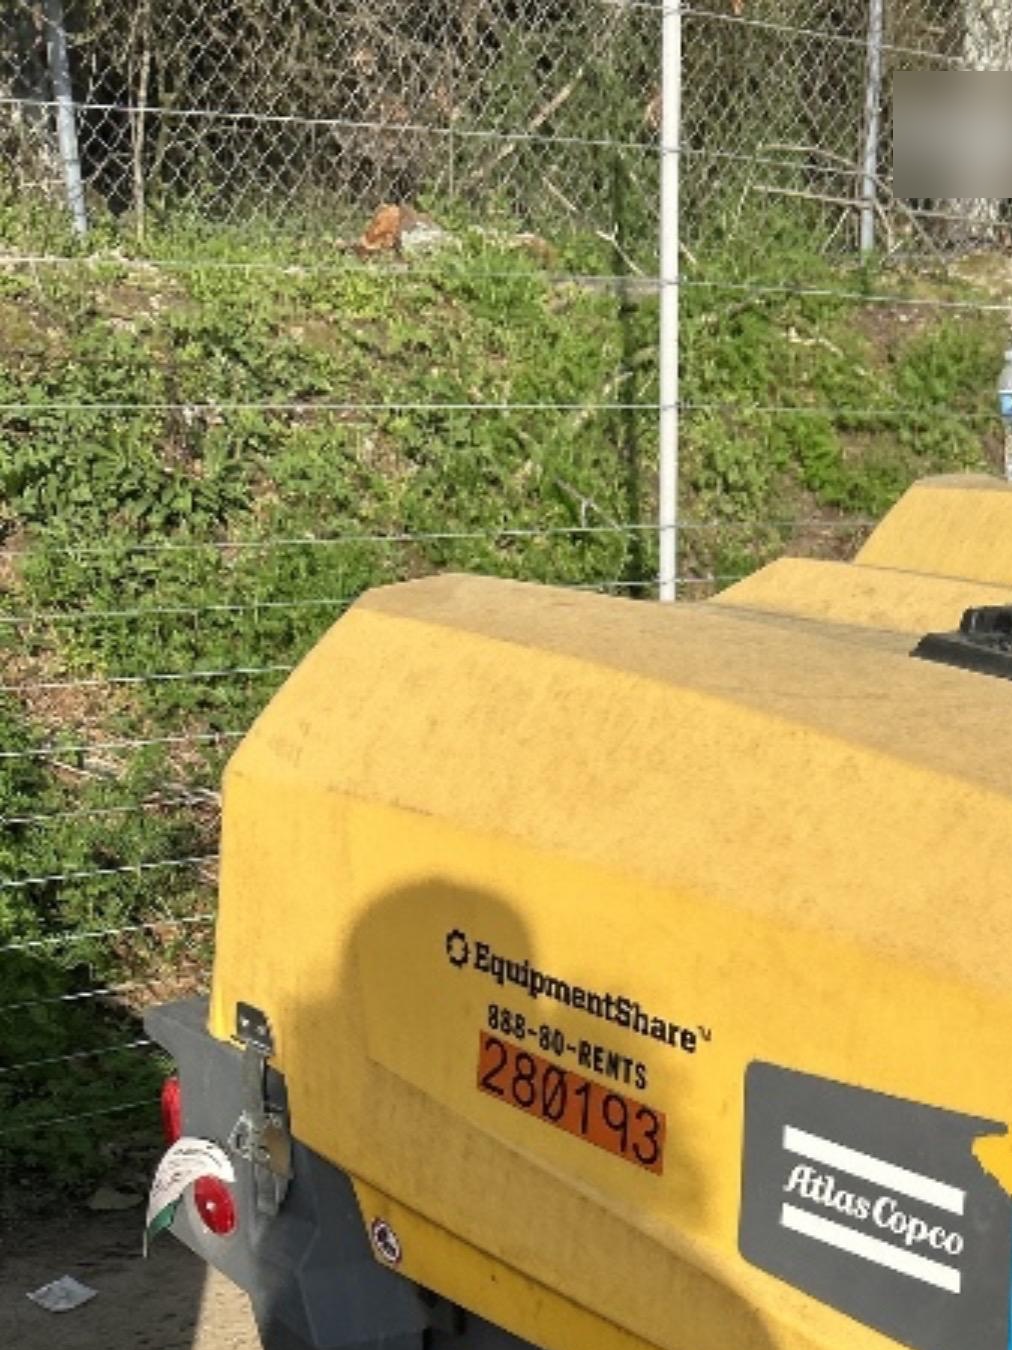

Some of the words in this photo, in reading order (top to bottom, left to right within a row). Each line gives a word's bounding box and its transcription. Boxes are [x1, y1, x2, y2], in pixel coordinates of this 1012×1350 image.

[488, 1004, 648, 1089] 888-80-RENTS
[481, 1038, 661, 1166] 280193
[783, 1164, 871, 1221] Atlas
[872, 1196, 964, 1255] Copco
